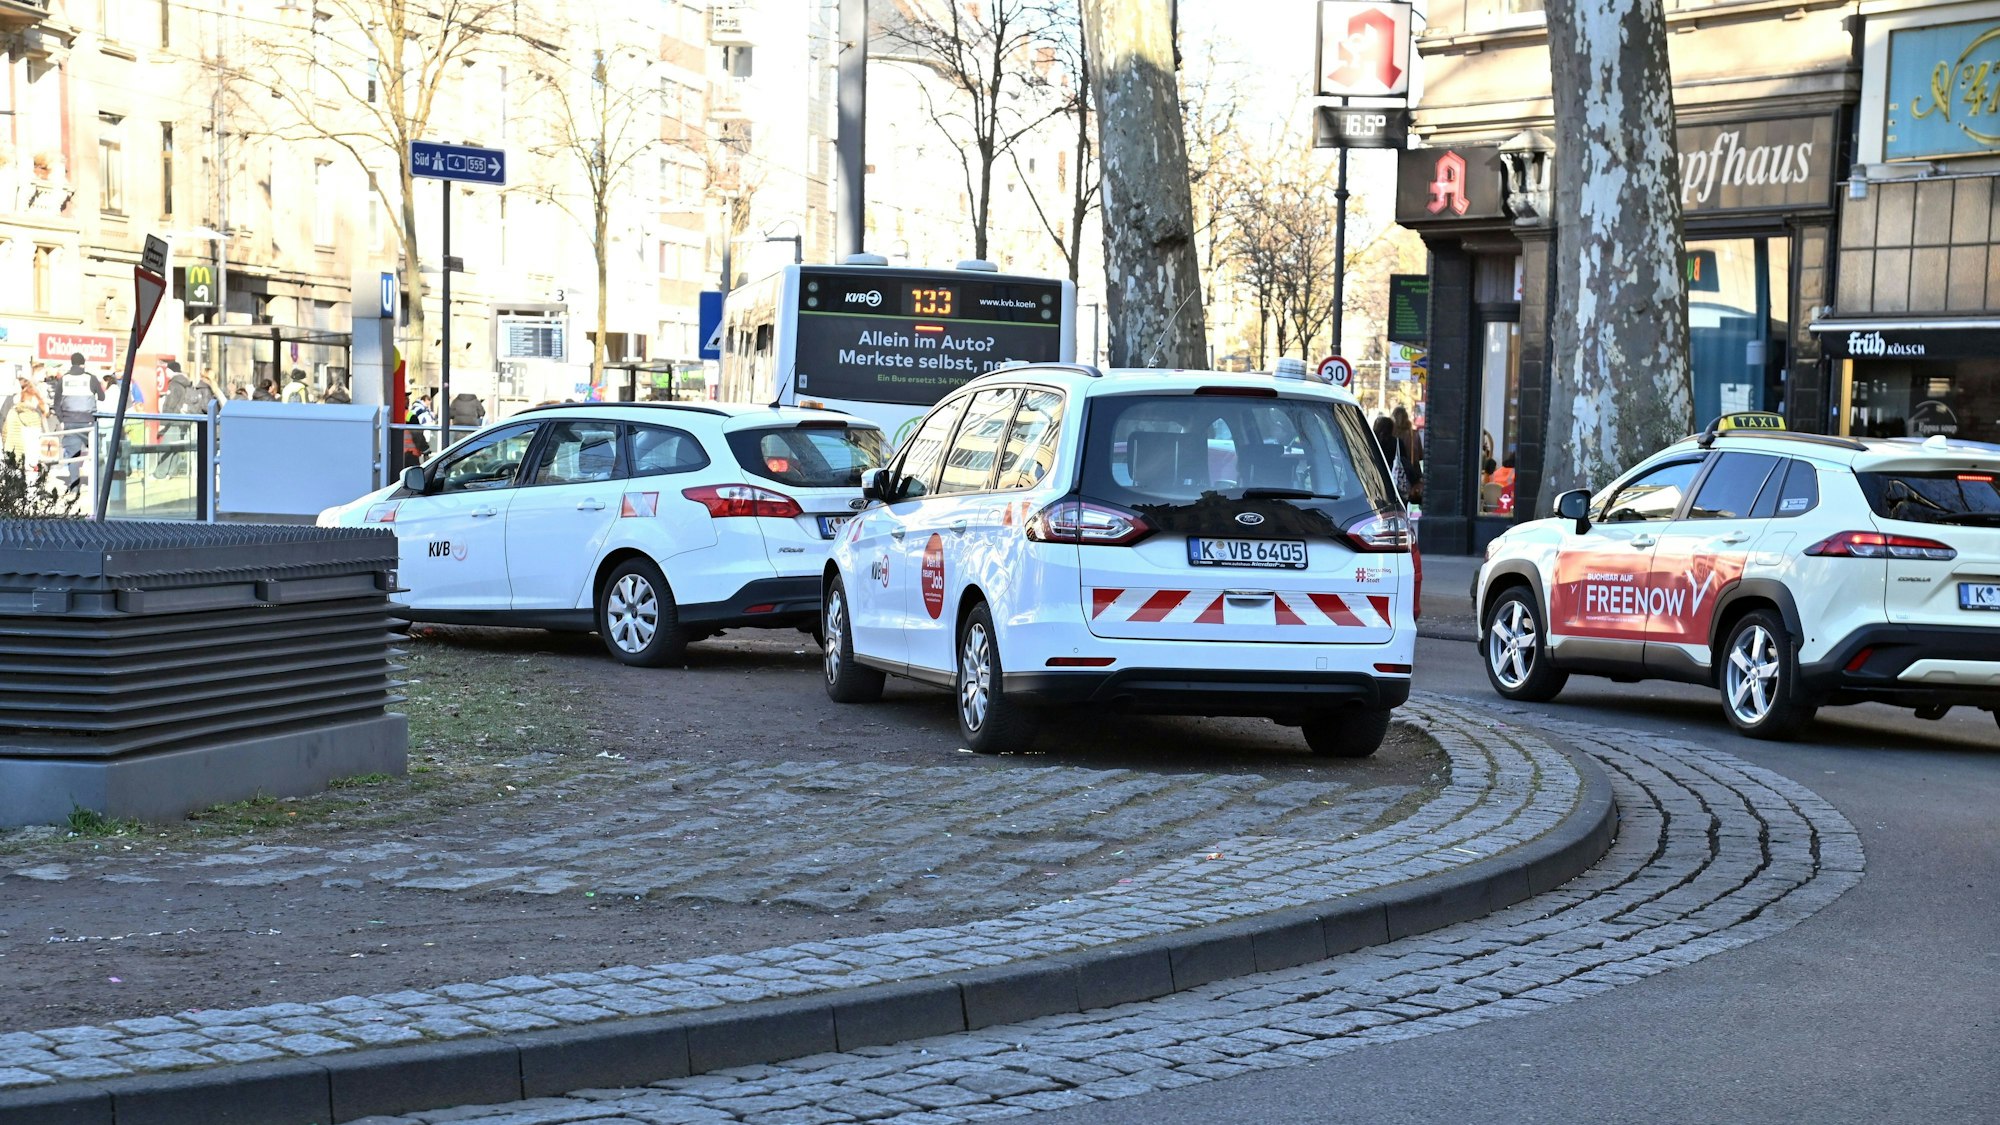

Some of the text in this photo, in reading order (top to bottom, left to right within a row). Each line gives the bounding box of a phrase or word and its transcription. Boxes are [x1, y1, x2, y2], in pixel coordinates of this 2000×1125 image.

[414, 152, 484, 171] Süd 4 555
[1678, 130, 1813, 204] pfhaus
[382, 279, 393, 313] U
[556, 289, 565, 302] 3
[845, 292, 867, 303] KVB
[911, 289, 952, 315] 133
[979, 298, 1036, 309] www.kvb.koeln
[858, 331, 995, 352] Allein im Auto?
[1847, 330, 1926, 357] früh KÖLSCH
[838, 349, 914, 368] Merkste
[918, 353, 978, 373] selbst,
[877, 374, 890, 383] Ein
[892, 375, 906, 384] Bus
[907, 376, 936, 385] ersetzt
[937, 377, 948, 385] 34
[1324, 365, 1345, 381] 30
[1738, 416, 1775, 428] TAXI
[827, 518, 838, 534] K
[428, 540, 451, 558] KVB
[1201, 541, 1303, 562] K VB 6405
[871, 561, 882, 580] KVB
[930, 570, 943, 590] Job
[1587, 572, 1634, 582] BUCHBAR AUF
[1586, 584, 1686, 617] FREENOW
[1975, 586, 1986, 603] K
